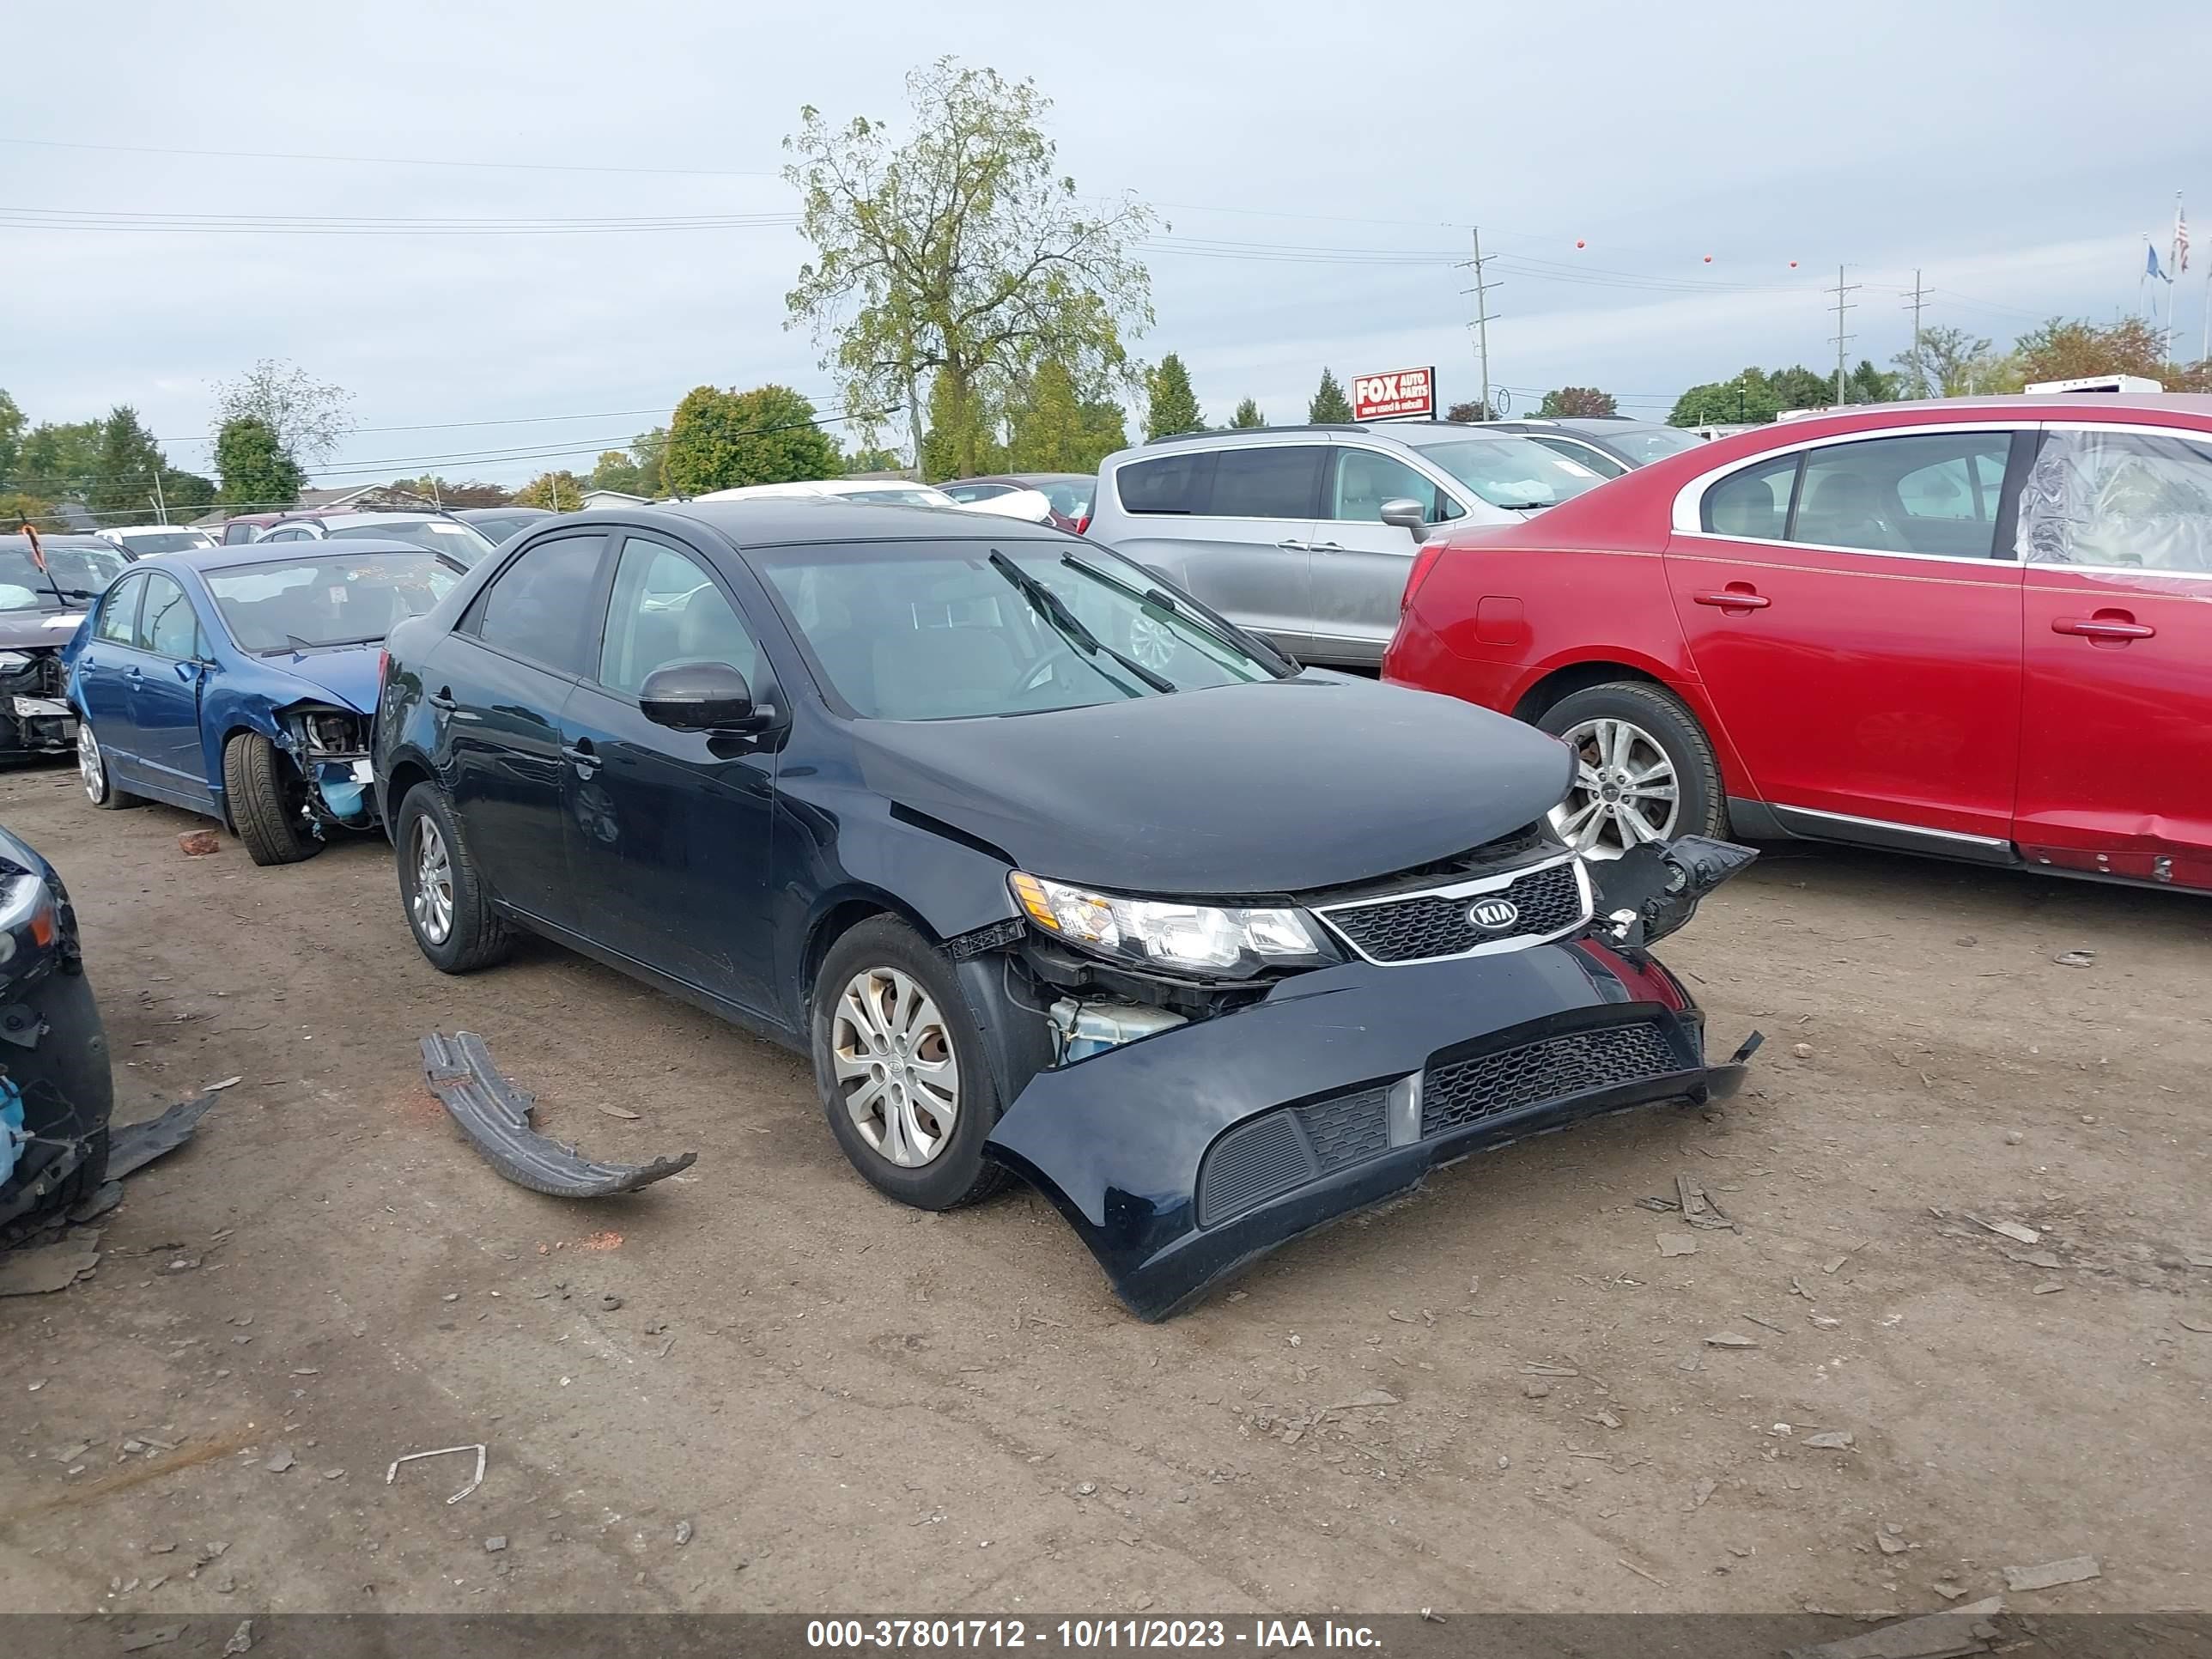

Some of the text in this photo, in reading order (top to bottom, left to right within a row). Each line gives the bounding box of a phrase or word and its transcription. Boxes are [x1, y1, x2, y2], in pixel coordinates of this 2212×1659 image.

[1401, 373, 1425, 386] AUTO
[1357, 376, 1400, 404] FOX
[1401, 385, 1428, 399] PARTS
[1377, 402, 1395, 413] used
[1477, 903, 1513, 924] KIA
